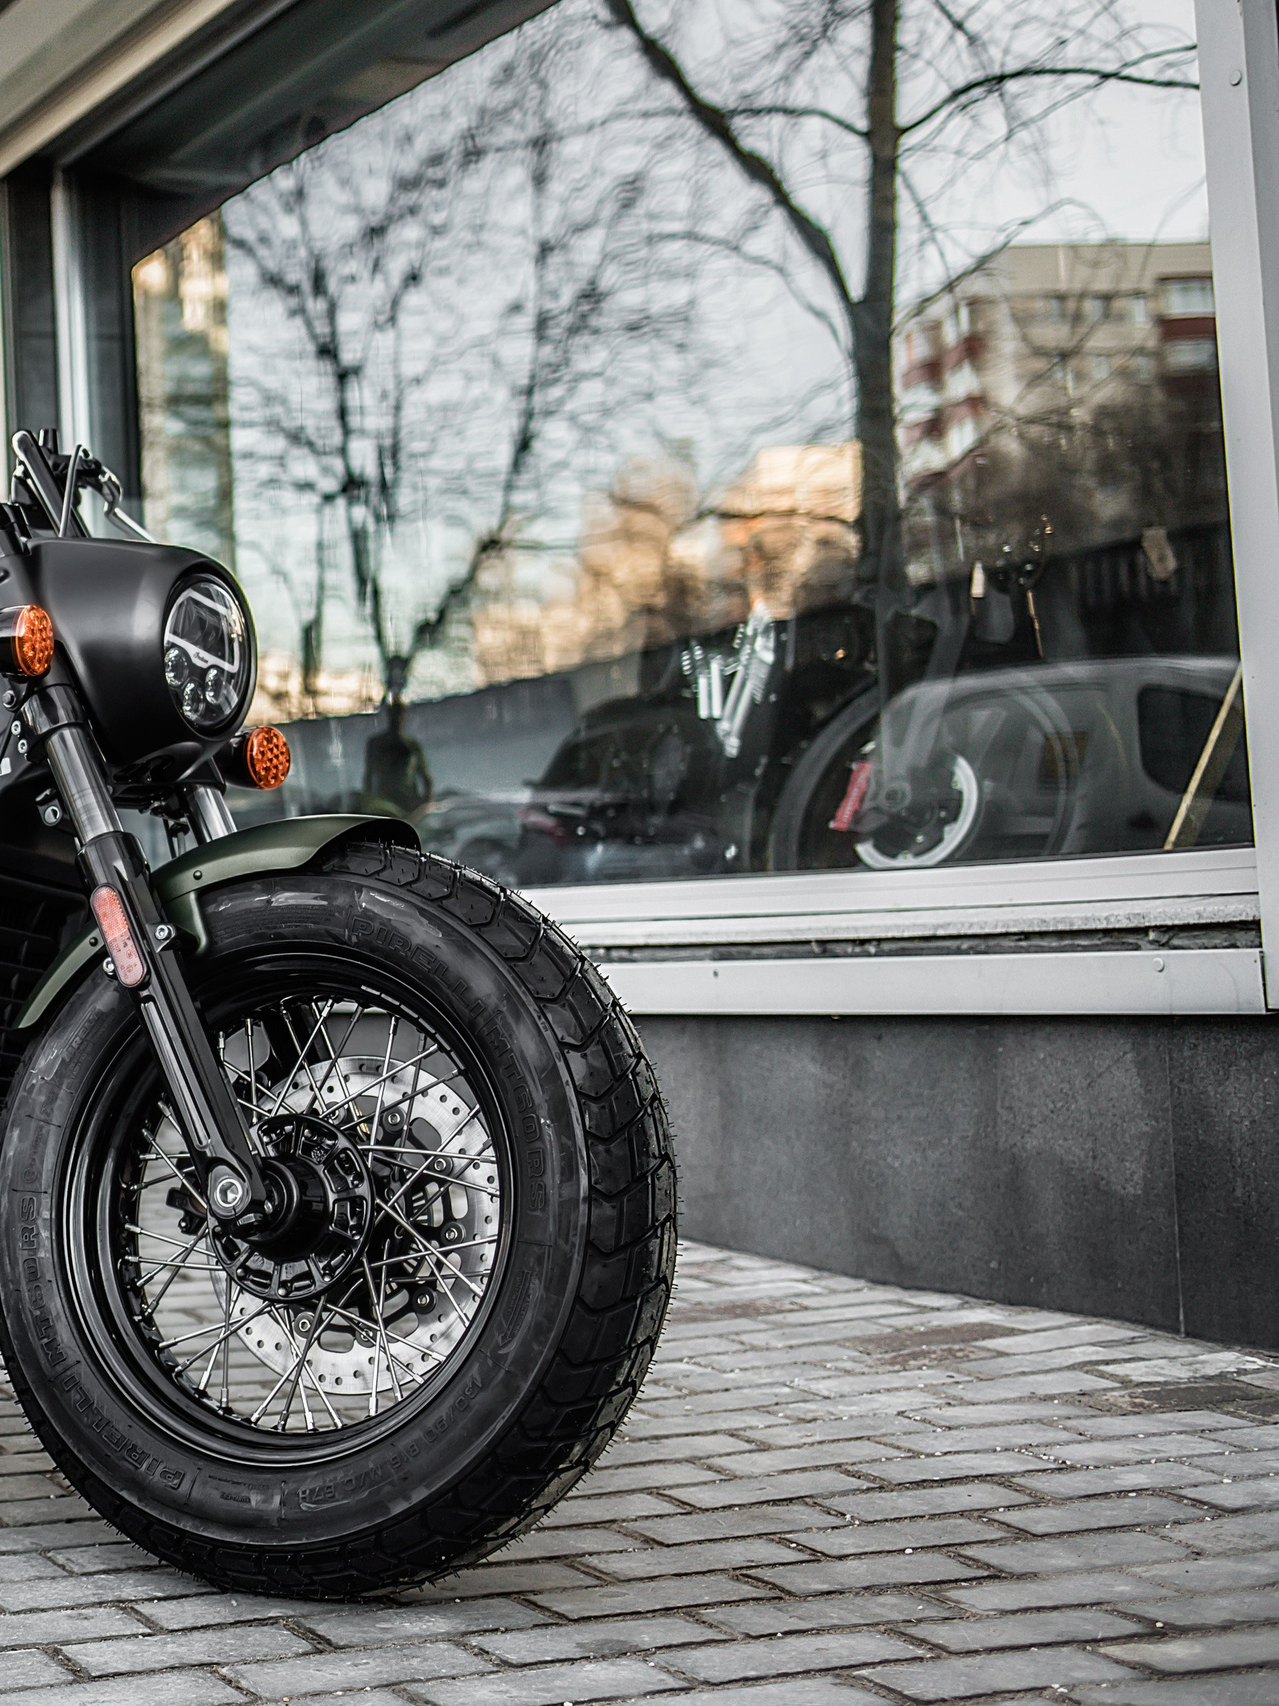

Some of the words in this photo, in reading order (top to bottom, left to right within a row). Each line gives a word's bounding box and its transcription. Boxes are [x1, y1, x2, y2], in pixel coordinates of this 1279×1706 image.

[349, 916, 488, 1019] PIRELLI
[62, 1373, 186, 1490] PIRELLI
[423, 1376, 482, 1444] 130/90
[344, 1468, 383, 1492] M/C
